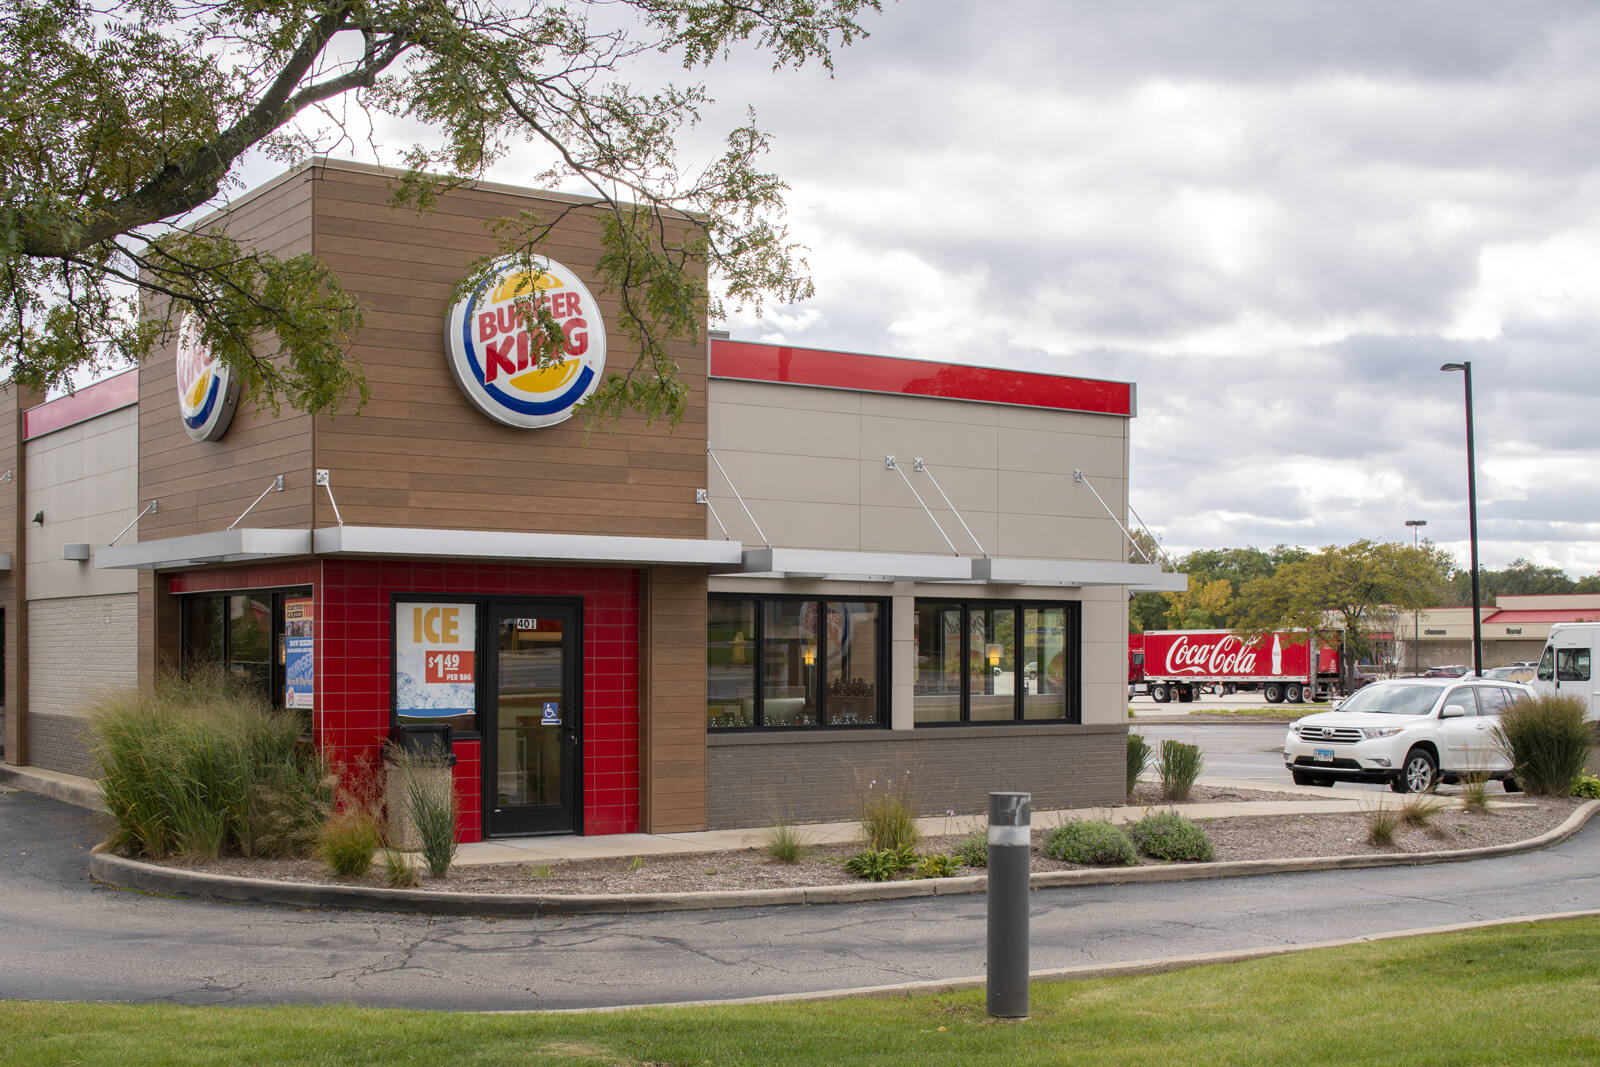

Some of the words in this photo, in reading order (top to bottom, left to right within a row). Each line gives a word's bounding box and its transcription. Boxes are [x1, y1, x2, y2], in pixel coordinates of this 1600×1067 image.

[413, 607, 459, 644] ICE
[517, 619, 535, 629] 401
[1165, 635, 1260, 674] Coca-Cola
[446, 673, 458, 681] PER
[459, 673, 472, 681] BAG
